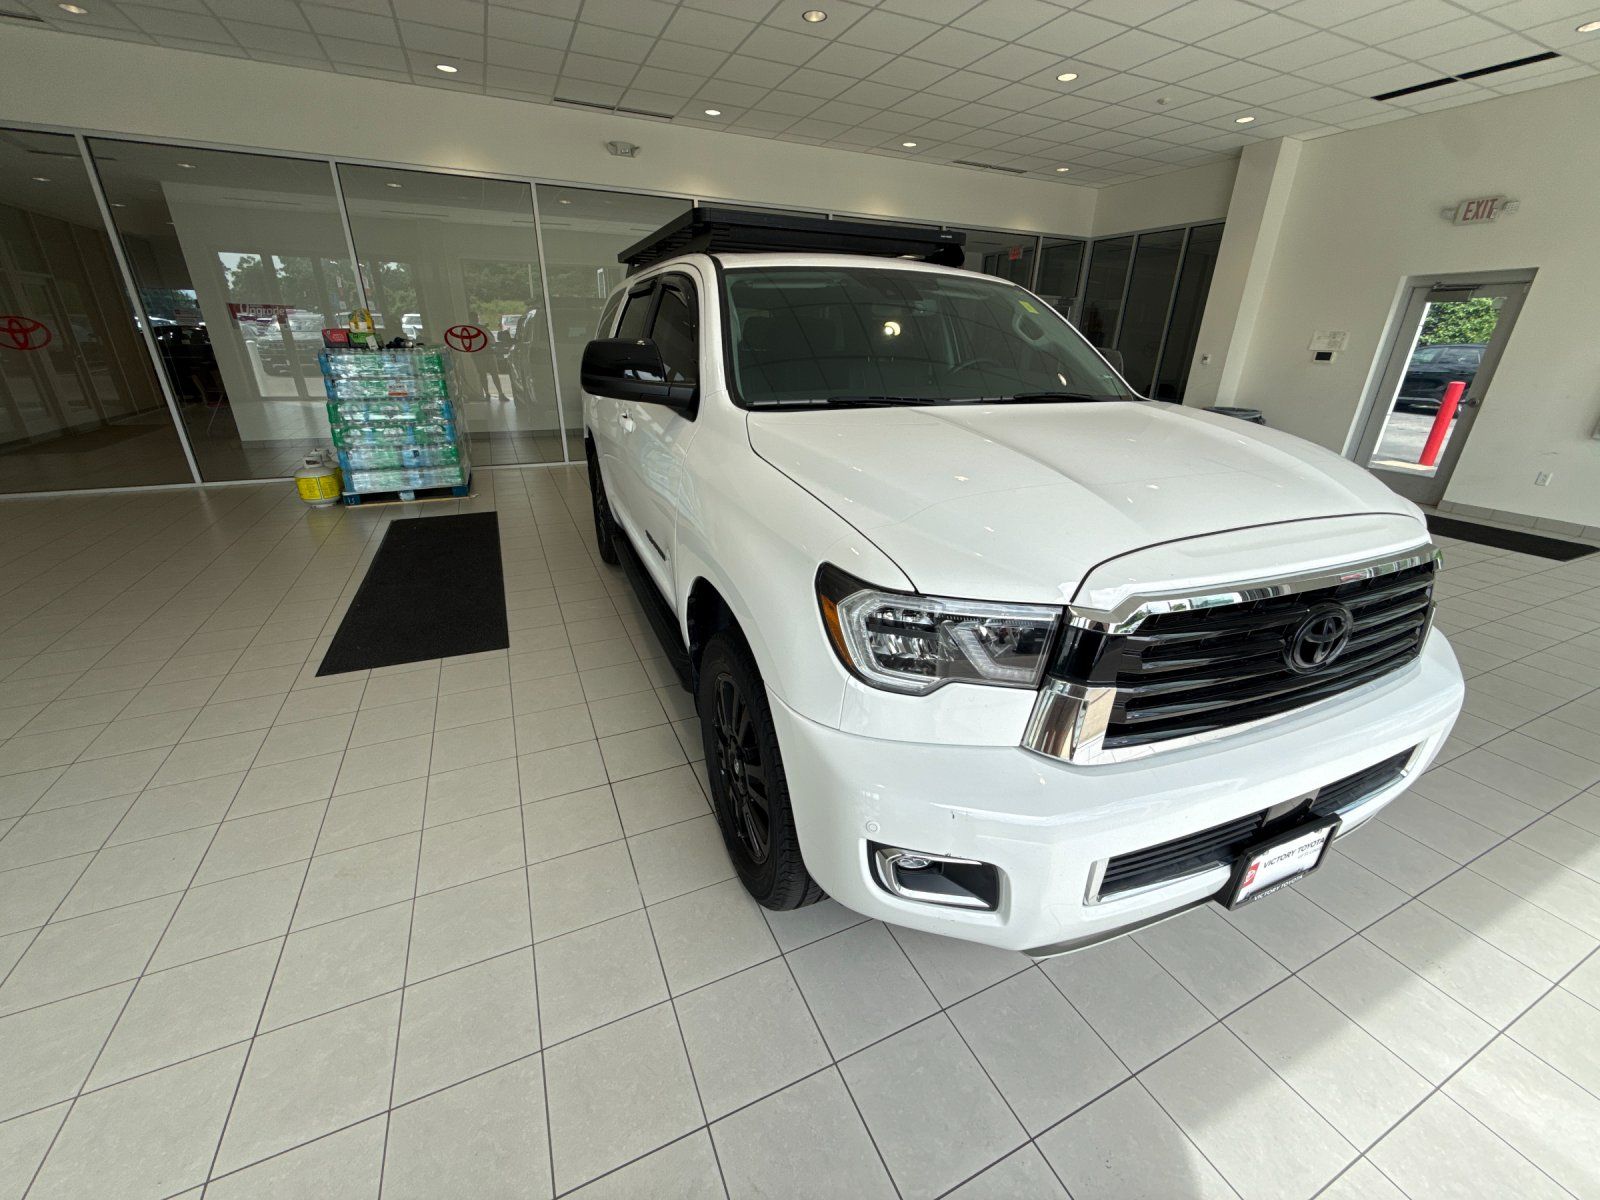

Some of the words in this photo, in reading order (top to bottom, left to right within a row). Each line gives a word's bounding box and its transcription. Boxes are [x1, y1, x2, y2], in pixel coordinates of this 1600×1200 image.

[1462, 198, 1498, 221] EXIT
[1263, 849, 1297, 869] VICTORY
[1297, 837, 1325, 853] TOYOTA
